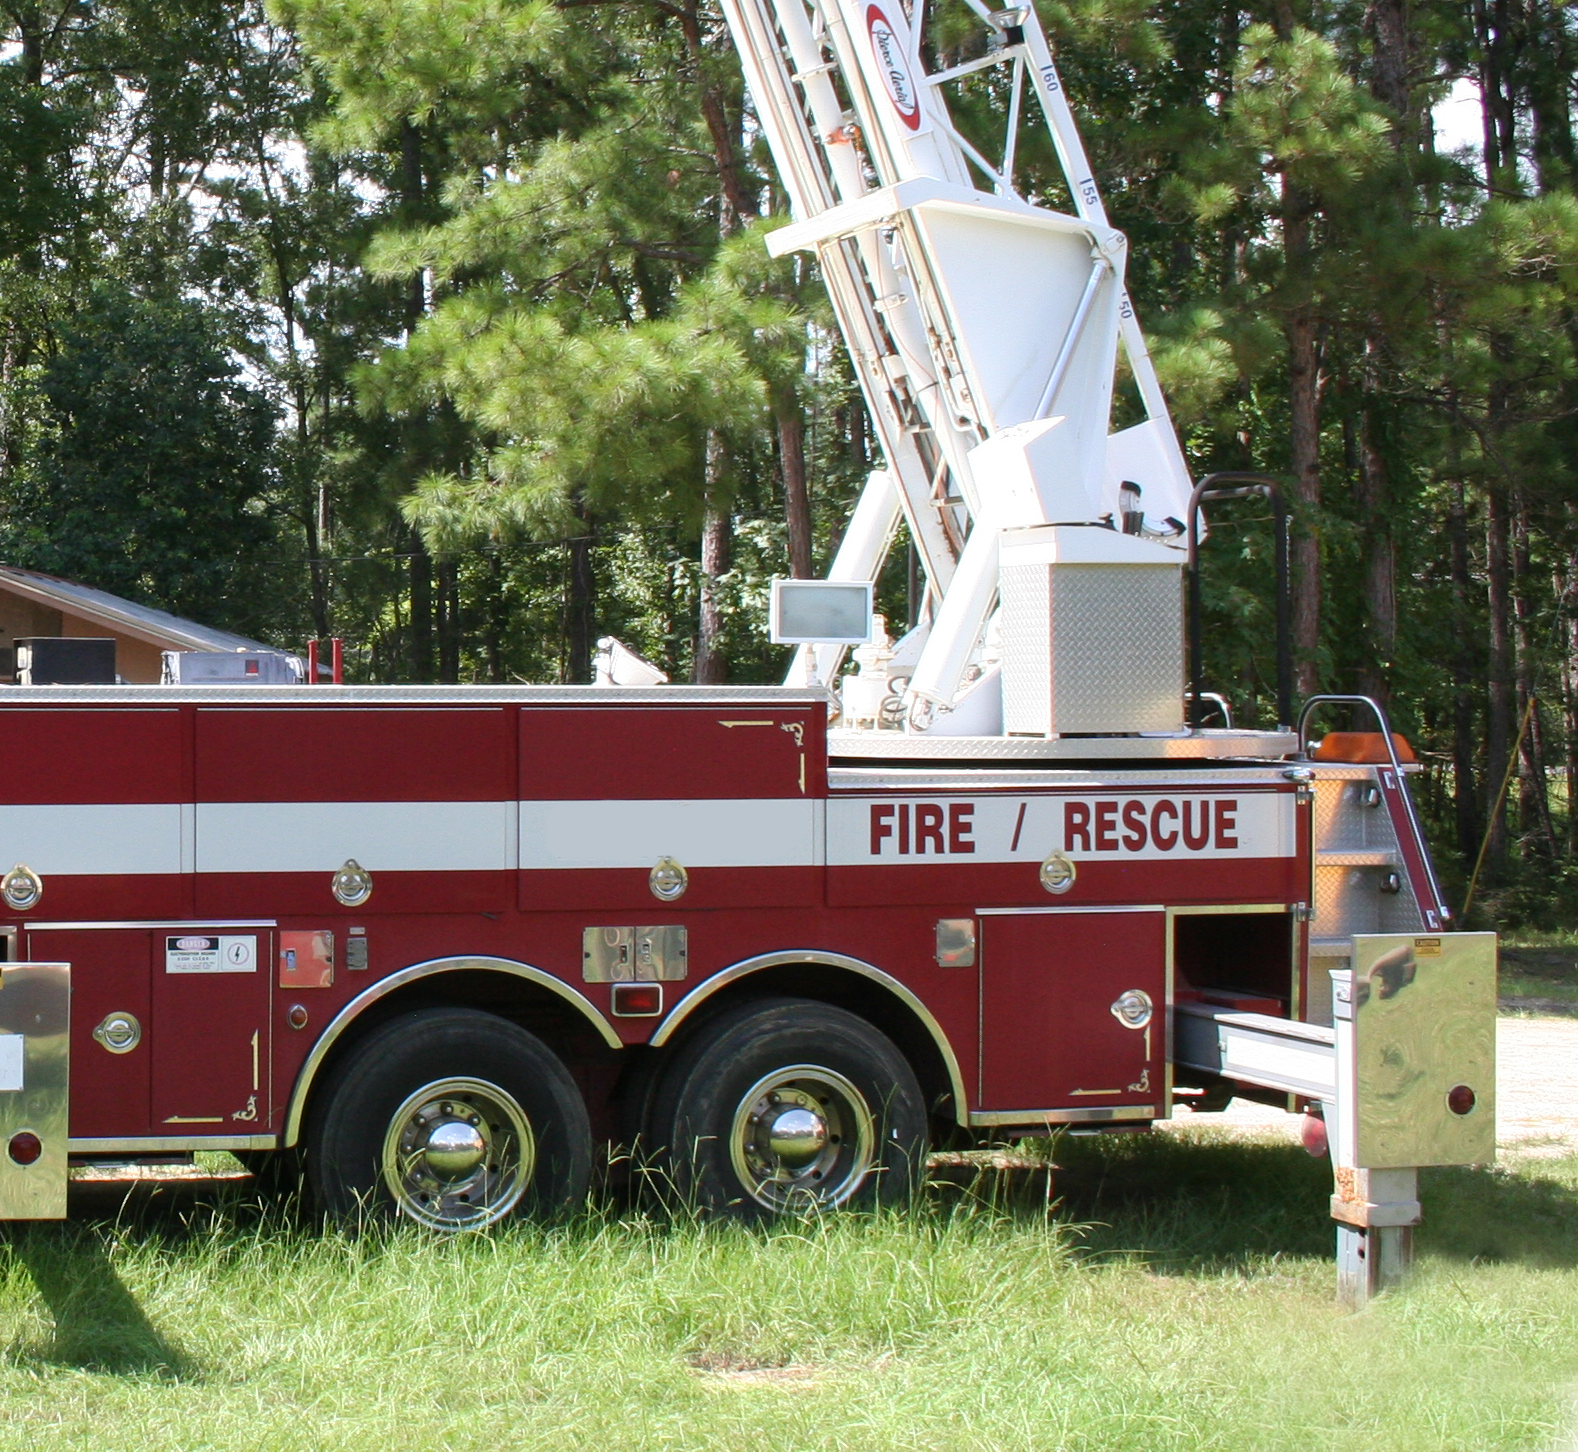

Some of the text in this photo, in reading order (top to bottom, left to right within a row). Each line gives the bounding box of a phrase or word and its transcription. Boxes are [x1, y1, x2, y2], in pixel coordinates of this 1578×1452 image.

[872, 29, 915, 109] Pierce Aerial
[870, 800, 1239, 855] FIRE / RESCUE
